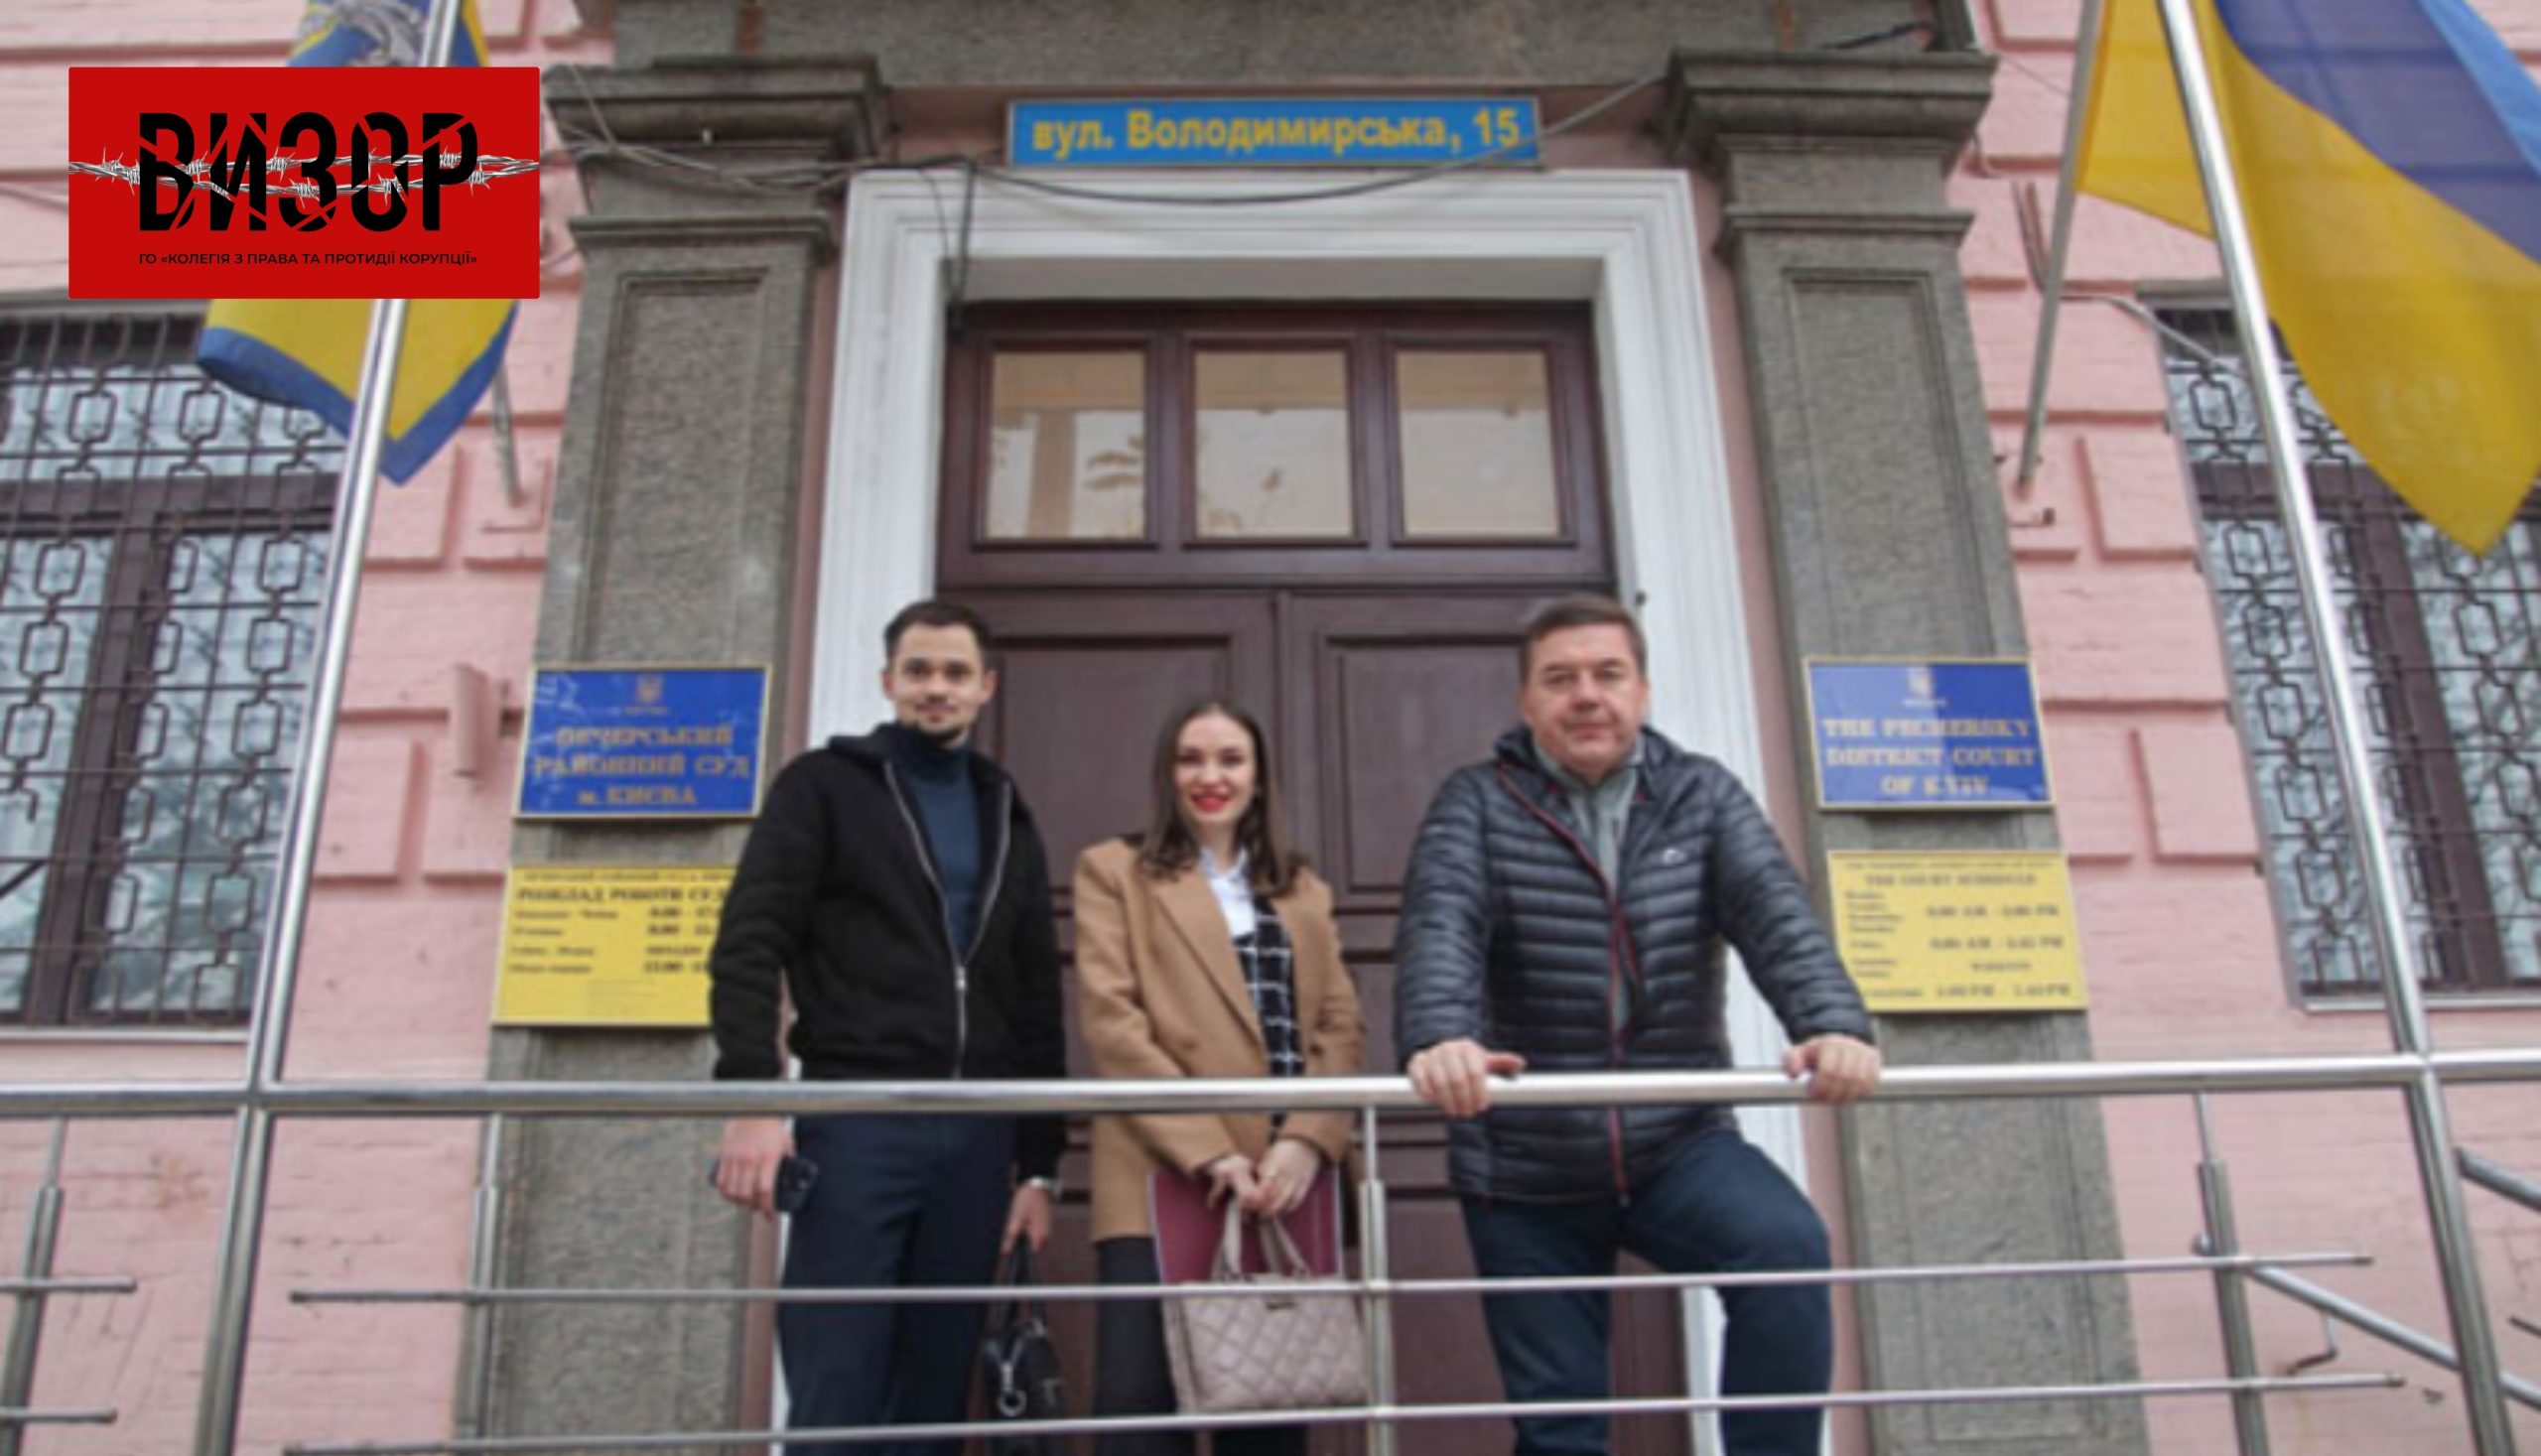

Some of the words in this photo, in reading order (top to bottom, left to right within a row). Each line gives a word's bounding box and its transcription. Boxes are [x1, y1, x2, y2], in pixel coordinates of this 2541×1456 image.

[1032, 118, 1113, 158] вул.
[1128, 109, 1461, 155] Володимирська,
[1474, 108, 1520, 146] 15
[1822, 718, 1876, 736] THE
[1882, 718, 2030, 736] PECHERSKY
[534, 752, 685, 777] РАЙОННИЙ
[696, 754, 749, 778] СУД
[1826, 747, 1944, 766] DISTRICT
[1952, 746, 2034, 766] COURT
[1881, 775, 1914, 794] OF
